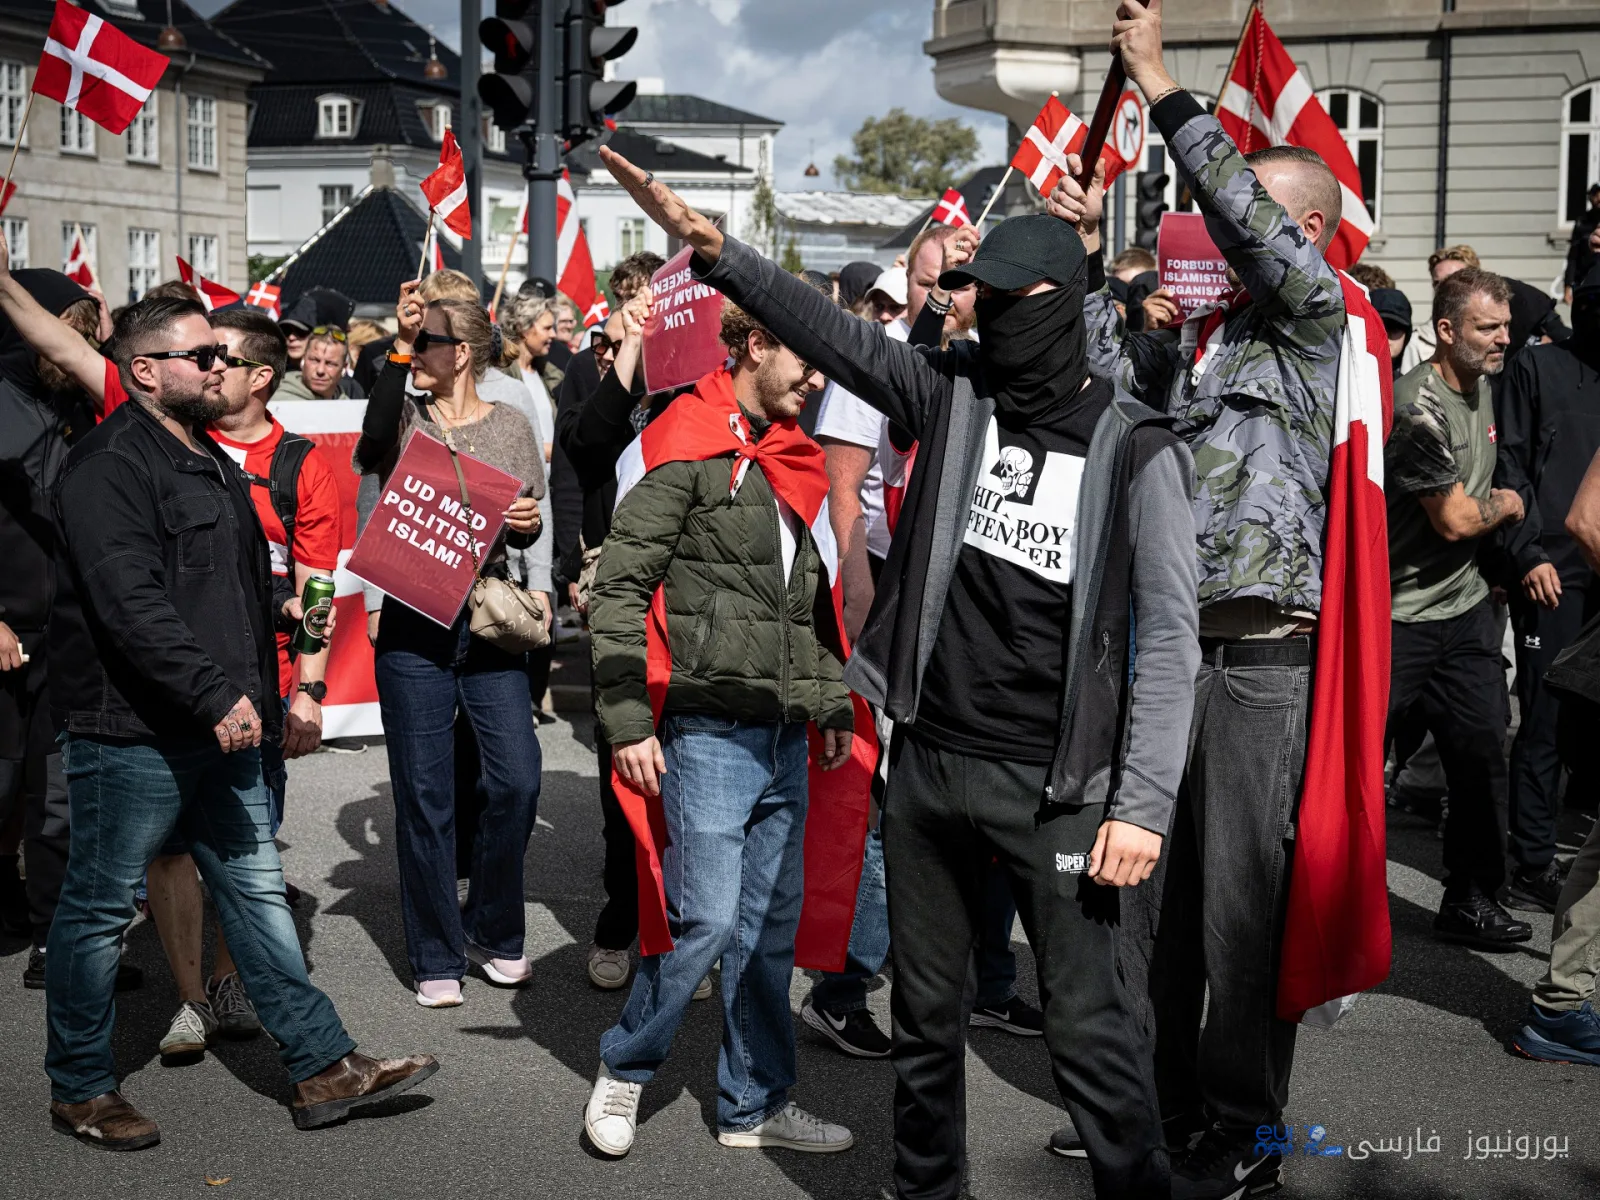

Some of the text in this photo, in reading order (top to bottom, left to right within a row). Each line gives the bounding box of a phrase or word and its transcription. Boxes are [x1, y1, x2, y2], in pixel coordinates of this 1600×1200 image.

[1164, 271, 1228, 284] ISLAMISTIS
[1167, 259, 1213, 271] FORBUD
[651, 267, 691, 296] SKÉEN!
[1161, 284, 1223, 296] ORGANISA
[664, 308, 695, 331] LUK
[403, 475, 487, 531] UD MED
[973, 484, 1069, 546] HIT BOY
[383, 490, 487, 557] POLITISK
[387, 518, 463, 569] ISLAM!
[1056, 852, 1085, 871] SUPER
